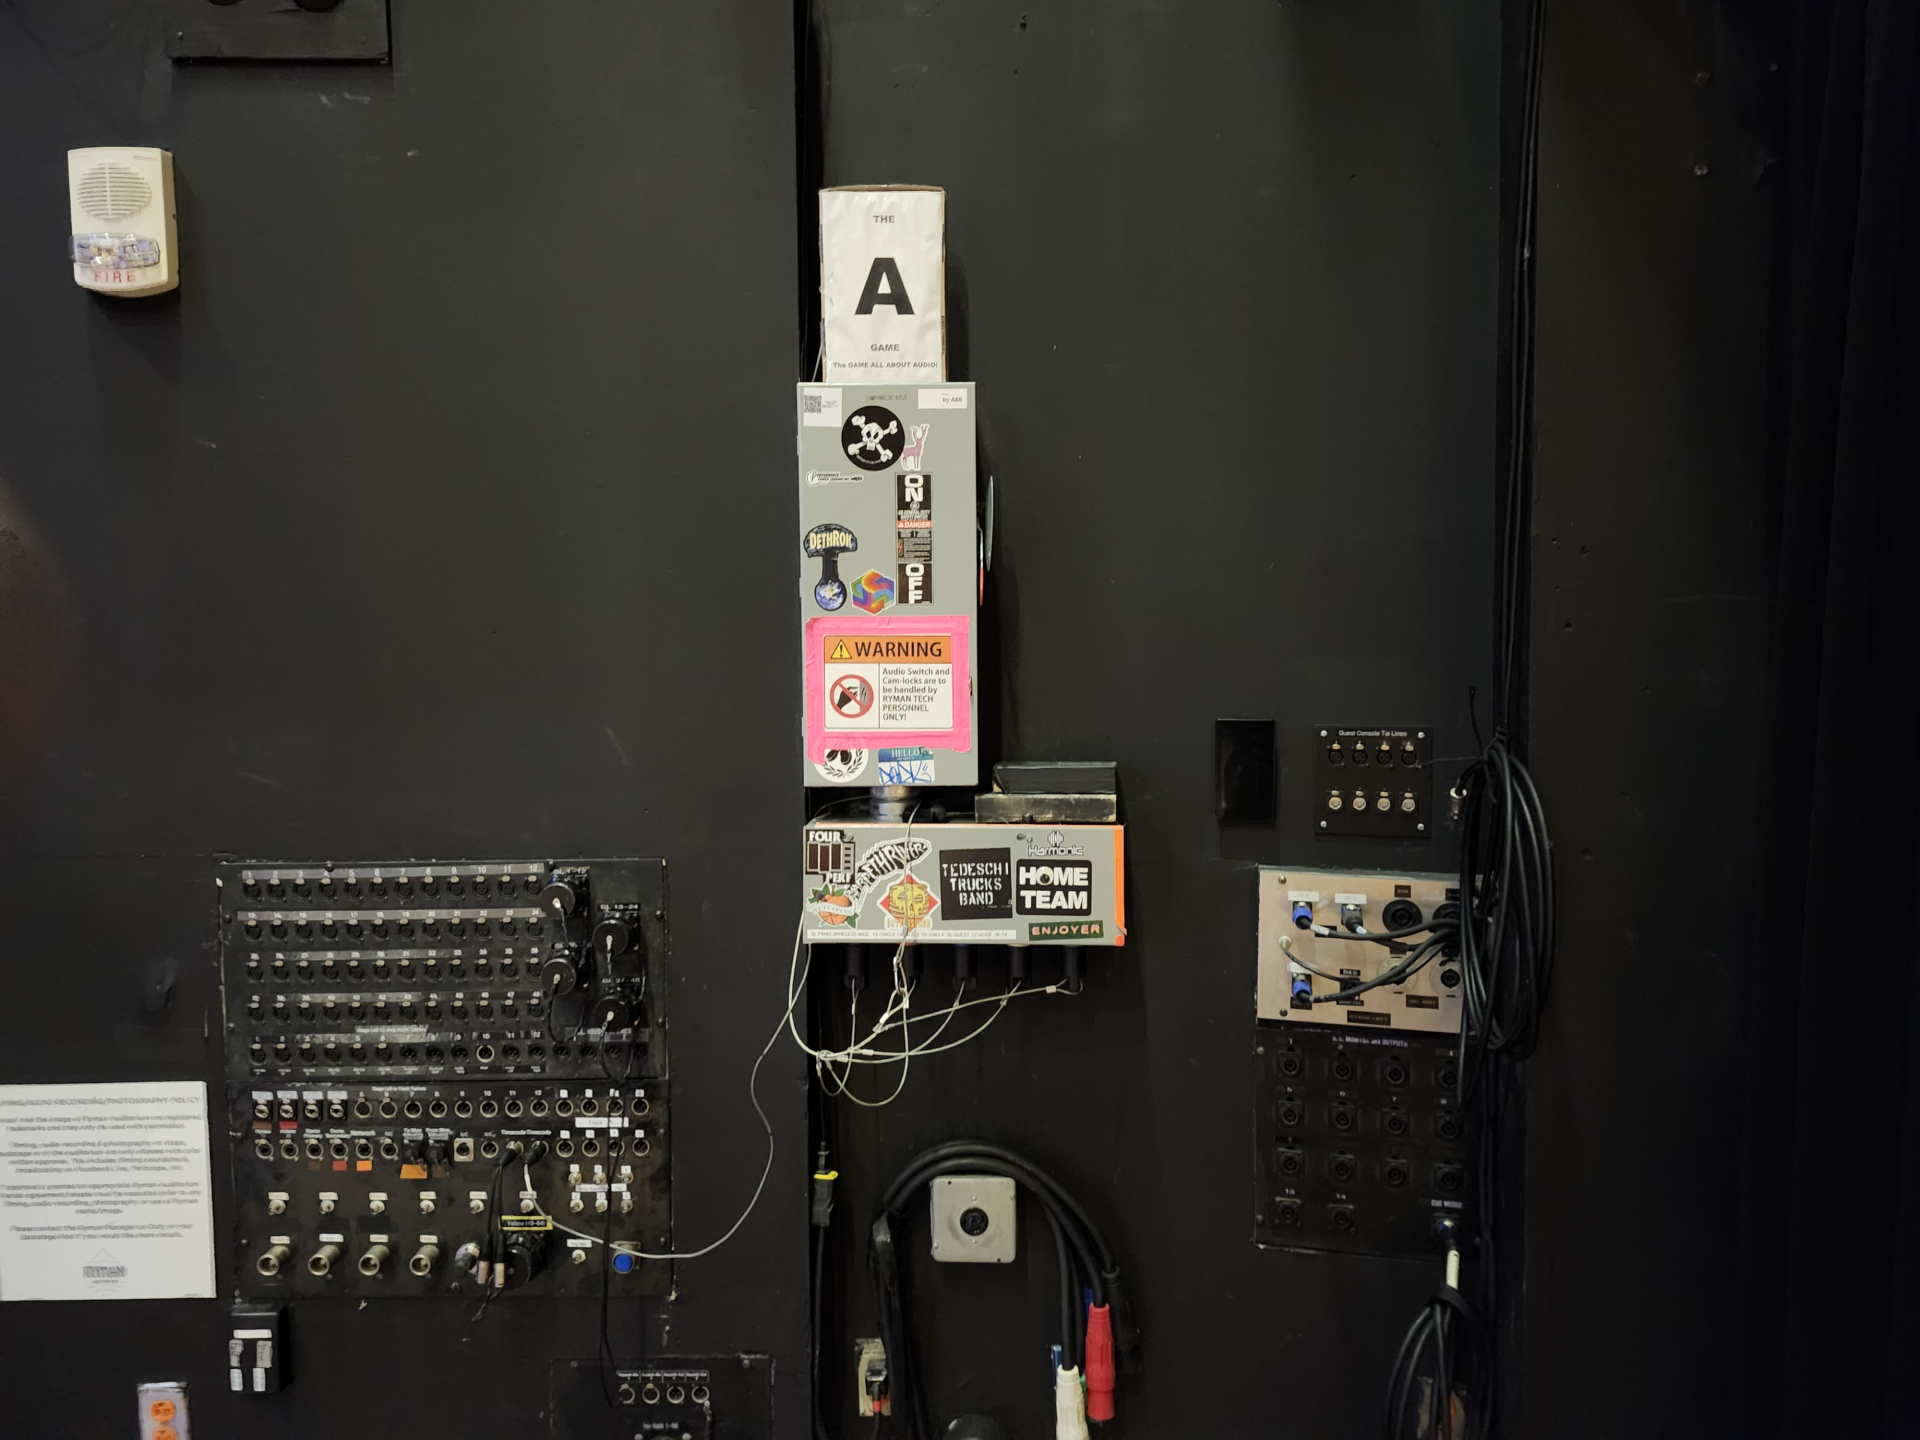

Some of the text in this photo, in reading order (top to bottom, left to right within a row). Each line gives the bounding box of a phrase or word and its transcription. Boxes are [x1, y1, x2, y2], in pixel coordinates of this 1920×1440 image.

[873, 215, 895, 223] THE
[94, 270, 136, 283] FIRE
[854, 257, 915, 316] A
[870, 344, 900, 352] GAME
[905, 474, 924, 503] ON
[904, 521, 931, 529] DANGER
[905, 563, 925, 605] OFF
[855, 641, 942, 658] WARNING
[882, 667, 950, 676] Audio Switch and
[882, 677, 923, 685] Cam-locks
[882, 686, 938, 695] be handled by
[882, 695, 934, 703] RYMAN TECH
[882, 704, 929, 712] PERSONNEL
[882, 713, 907, 721] ONLY!
[892, 749, 920, 758] HELLO
[808, 831, 841, 842] FOUR
[1027, 845, 1085, 857] Harmonic
[942, 862, 1009, 878] TEDESCHI
[826, 872, 852, 883] PERF
[1019, 865, 1090, 887] HOME
[950, 878, 1003, 892] TRUCKS
[959, 892, 994, 906] BAND
[1020, 890, 1088, 910] TEAM
[1032, 924, 1100, 936] ENJOYER
